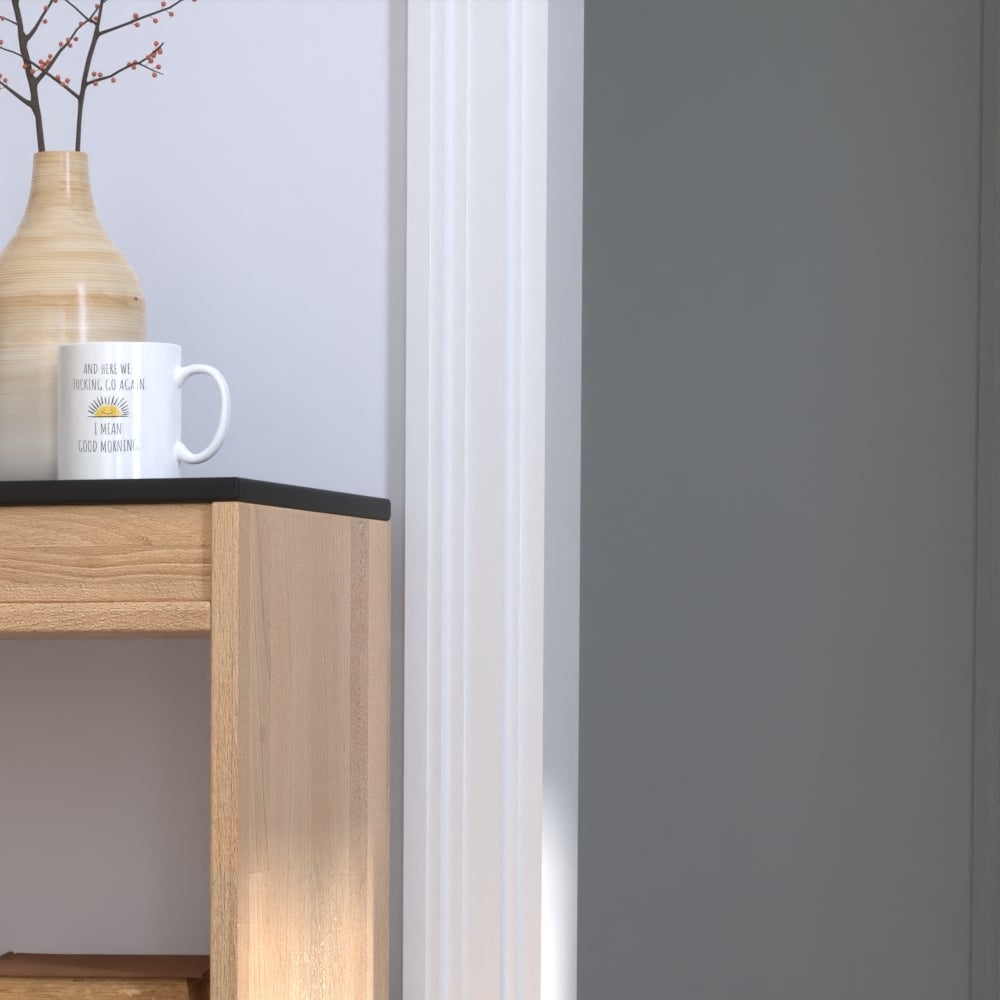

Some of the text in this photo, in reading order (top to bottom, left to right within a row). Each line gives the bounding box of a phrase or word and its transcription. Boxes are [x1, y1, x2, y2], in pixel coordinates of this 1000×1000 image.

[83, 363, 132, 375] AND HERE WE
[73, 379, 145, 391] FUCKING GO AGAN
[94, 422, 122, 435] I MEAN
[78, 440, 98, 453] GOOD
